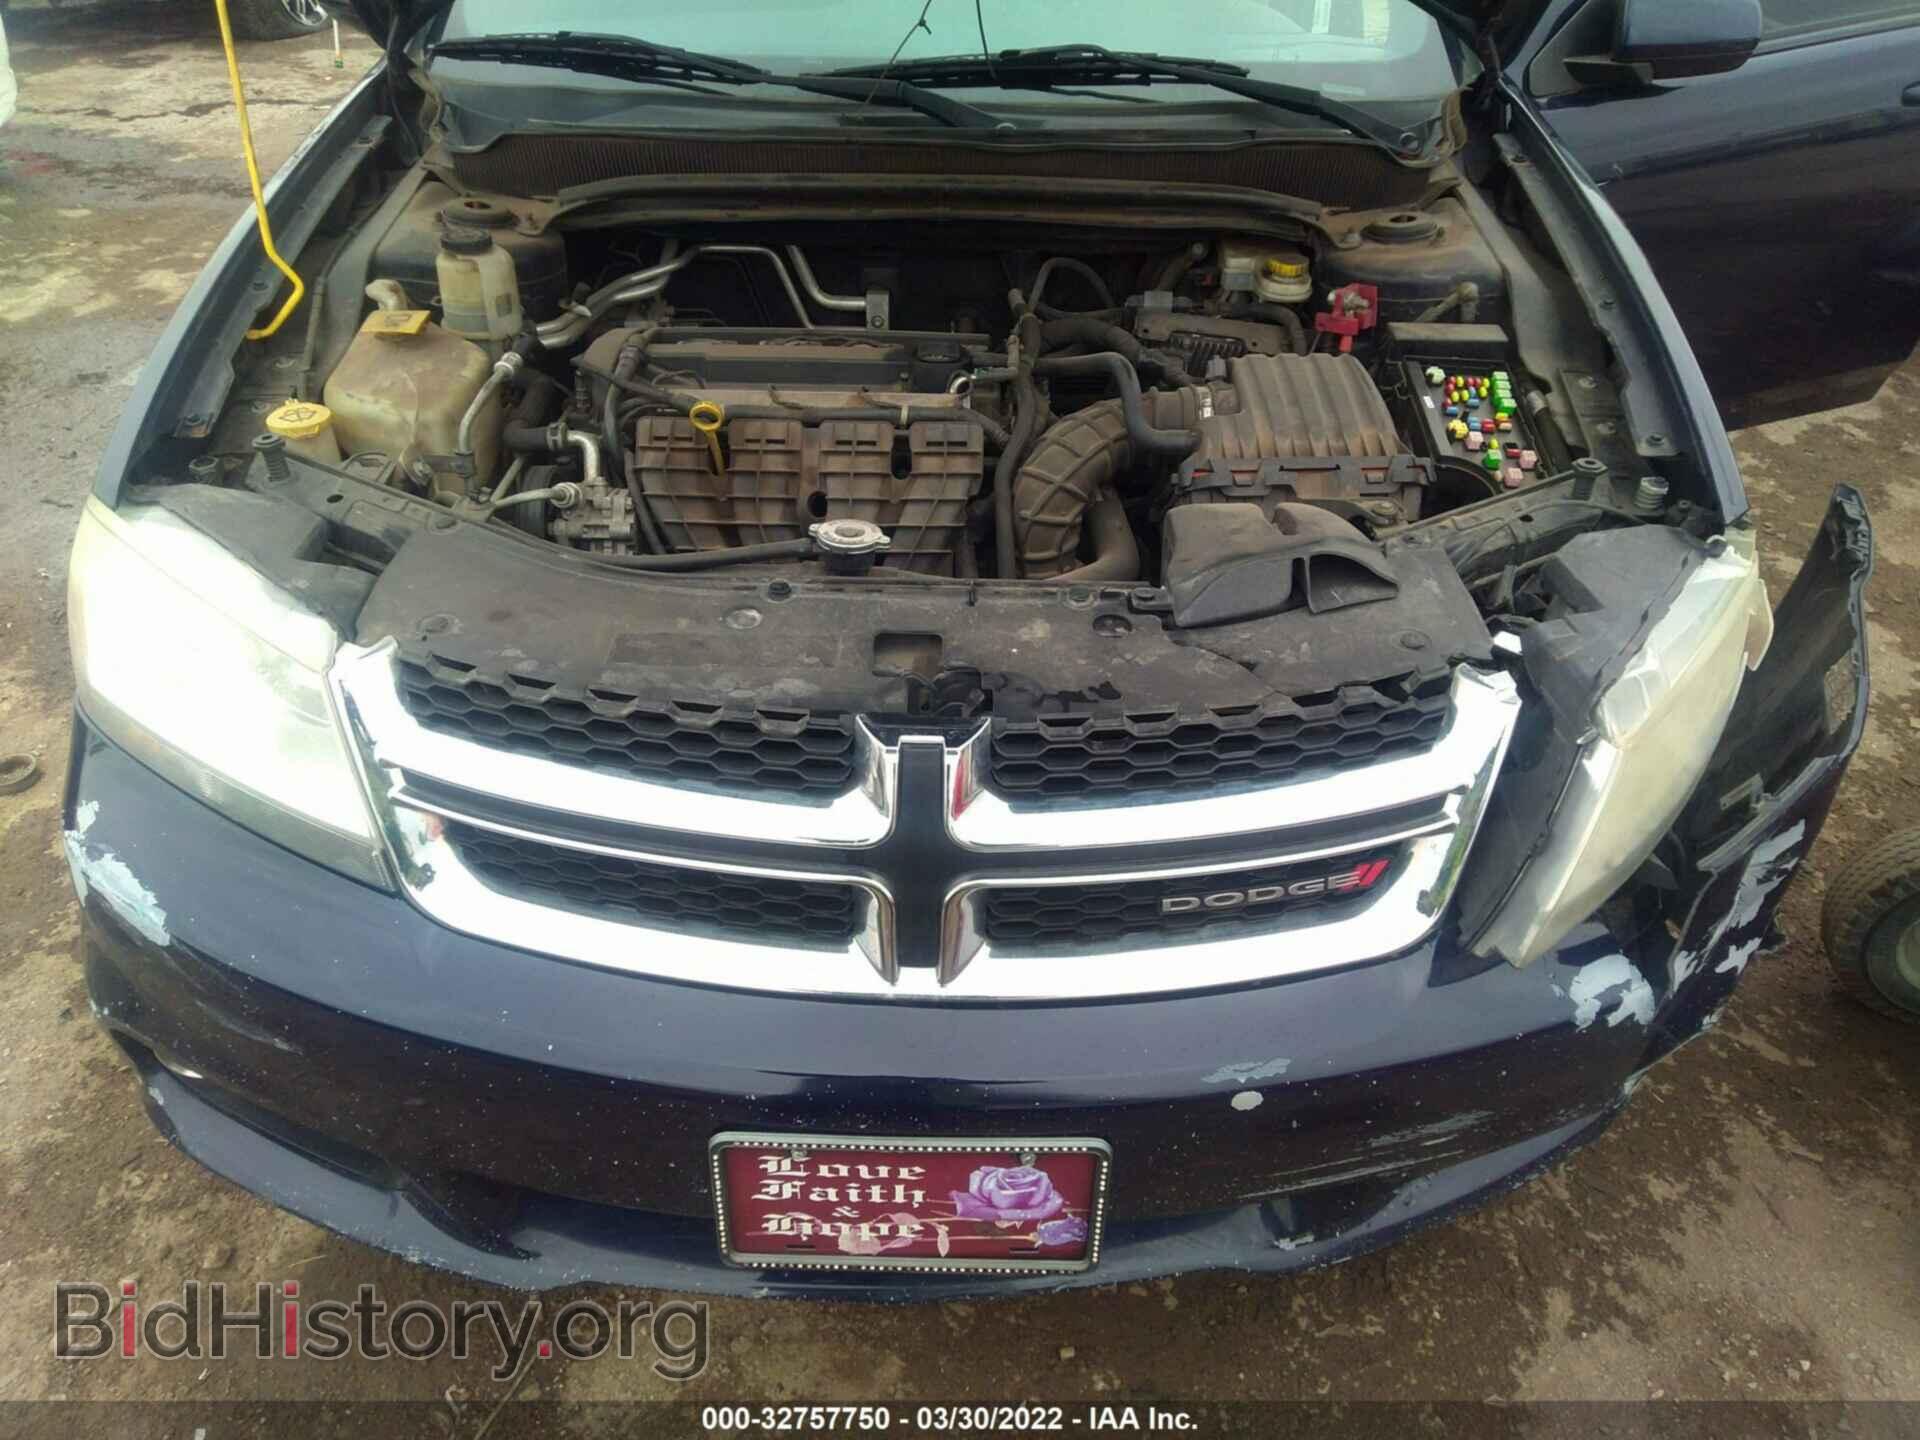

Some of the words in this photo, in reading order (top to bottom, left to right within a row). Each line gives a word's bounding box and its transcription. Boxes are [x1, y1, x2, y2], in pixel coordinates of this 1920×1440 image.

[1161, 870, 1361, 913] DODGE
[758, 1155, 927, 1180] Love
[751, 1179, 927, 1209] Faith
[831, 1205, 861, 1218] &
[760, 1213, 926, 1242] Hope
